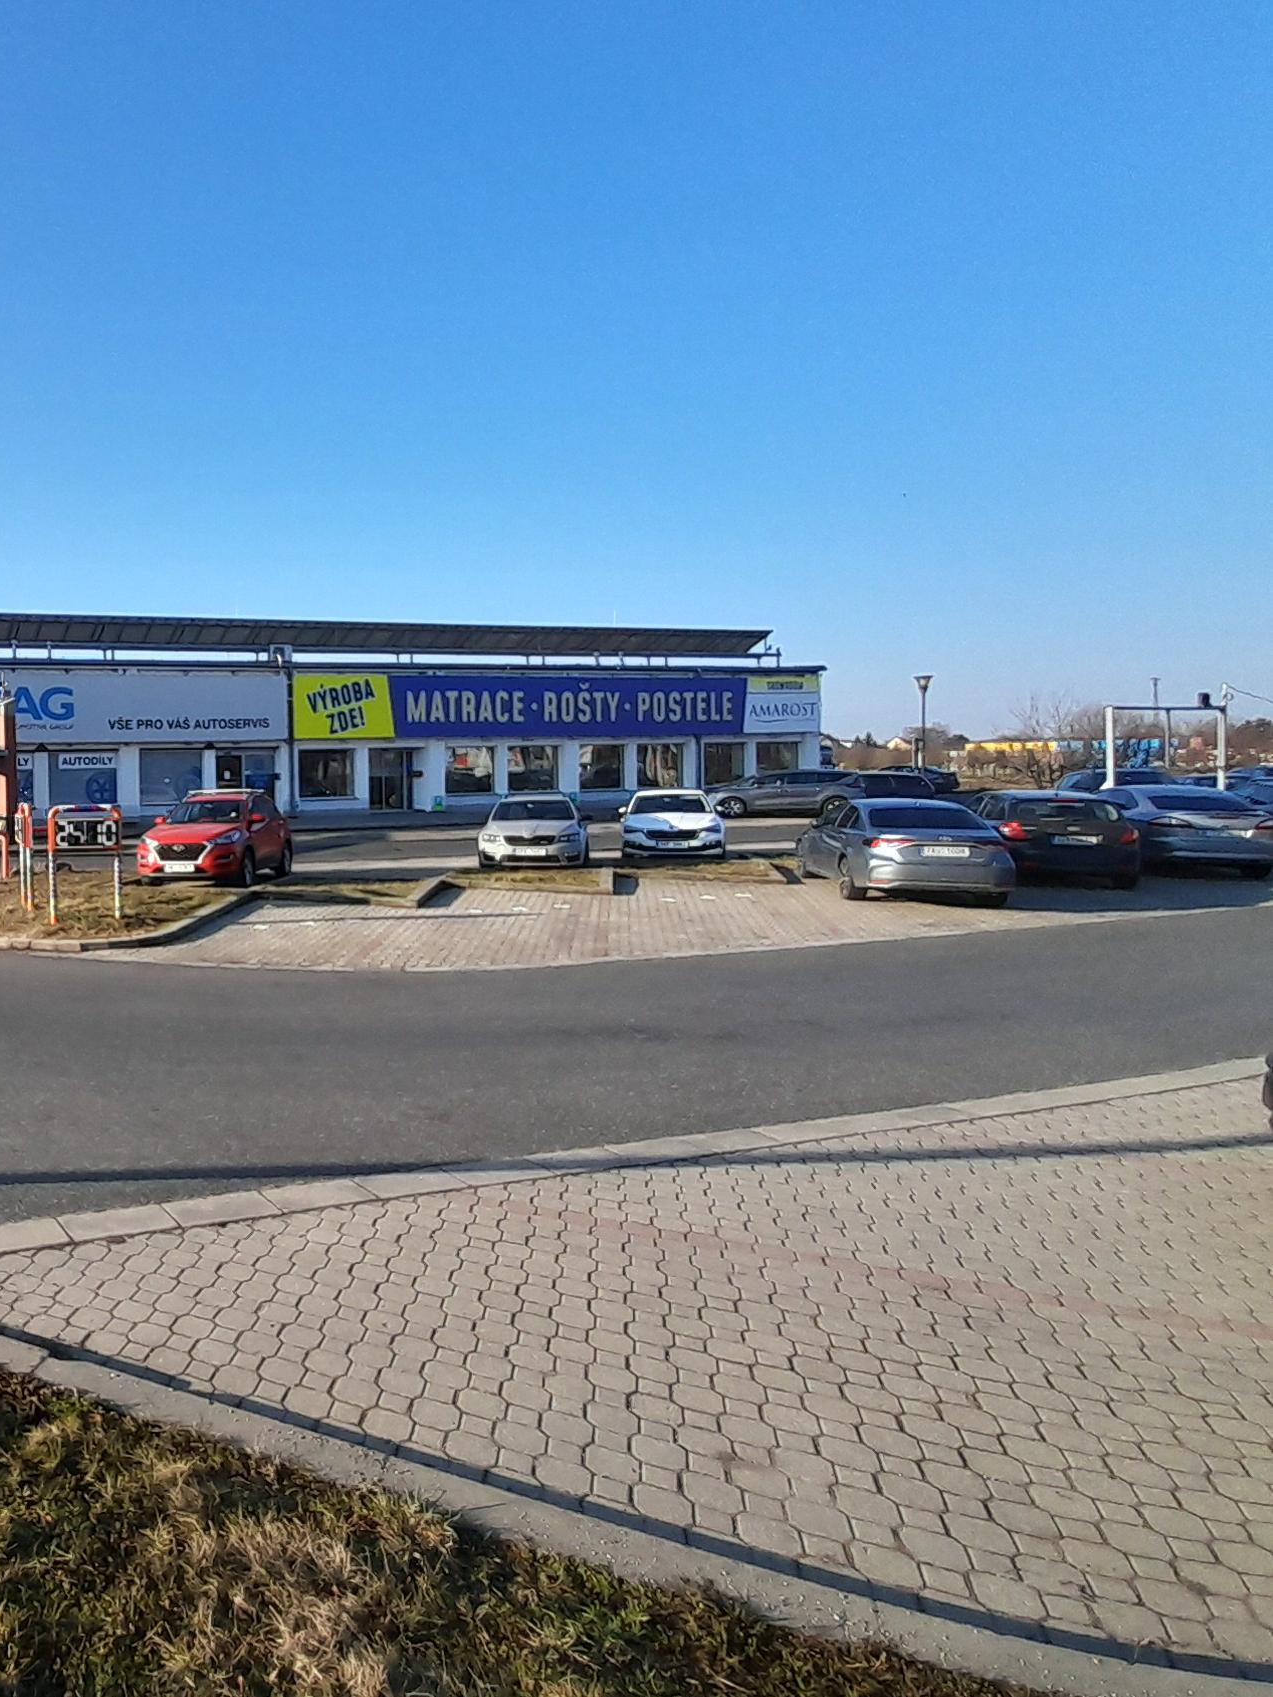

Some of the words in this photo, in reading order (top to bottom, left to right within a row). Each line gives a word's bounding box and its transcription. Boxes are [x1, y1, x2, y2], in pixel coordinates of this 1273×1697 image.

[306, 678, 376, 714] VÝROBA
[405, 690, 525, 723] MATRACE
[543, 681, 621, 723] ROŠTY
[637, 691, 734, 723] POSTELE
[326, 706, 366, 735] ZDE!
[749, 702, 819, 718] AMAROST
[108, 716, 133, 730] VŠE
[136, 718, 164, 730] PRO
[166, 716, 191, 730] VÁŠ
[193, 717, 270, 730] AUTOSERVIS
[61, 755, 114, 767] AUTODÍLY
